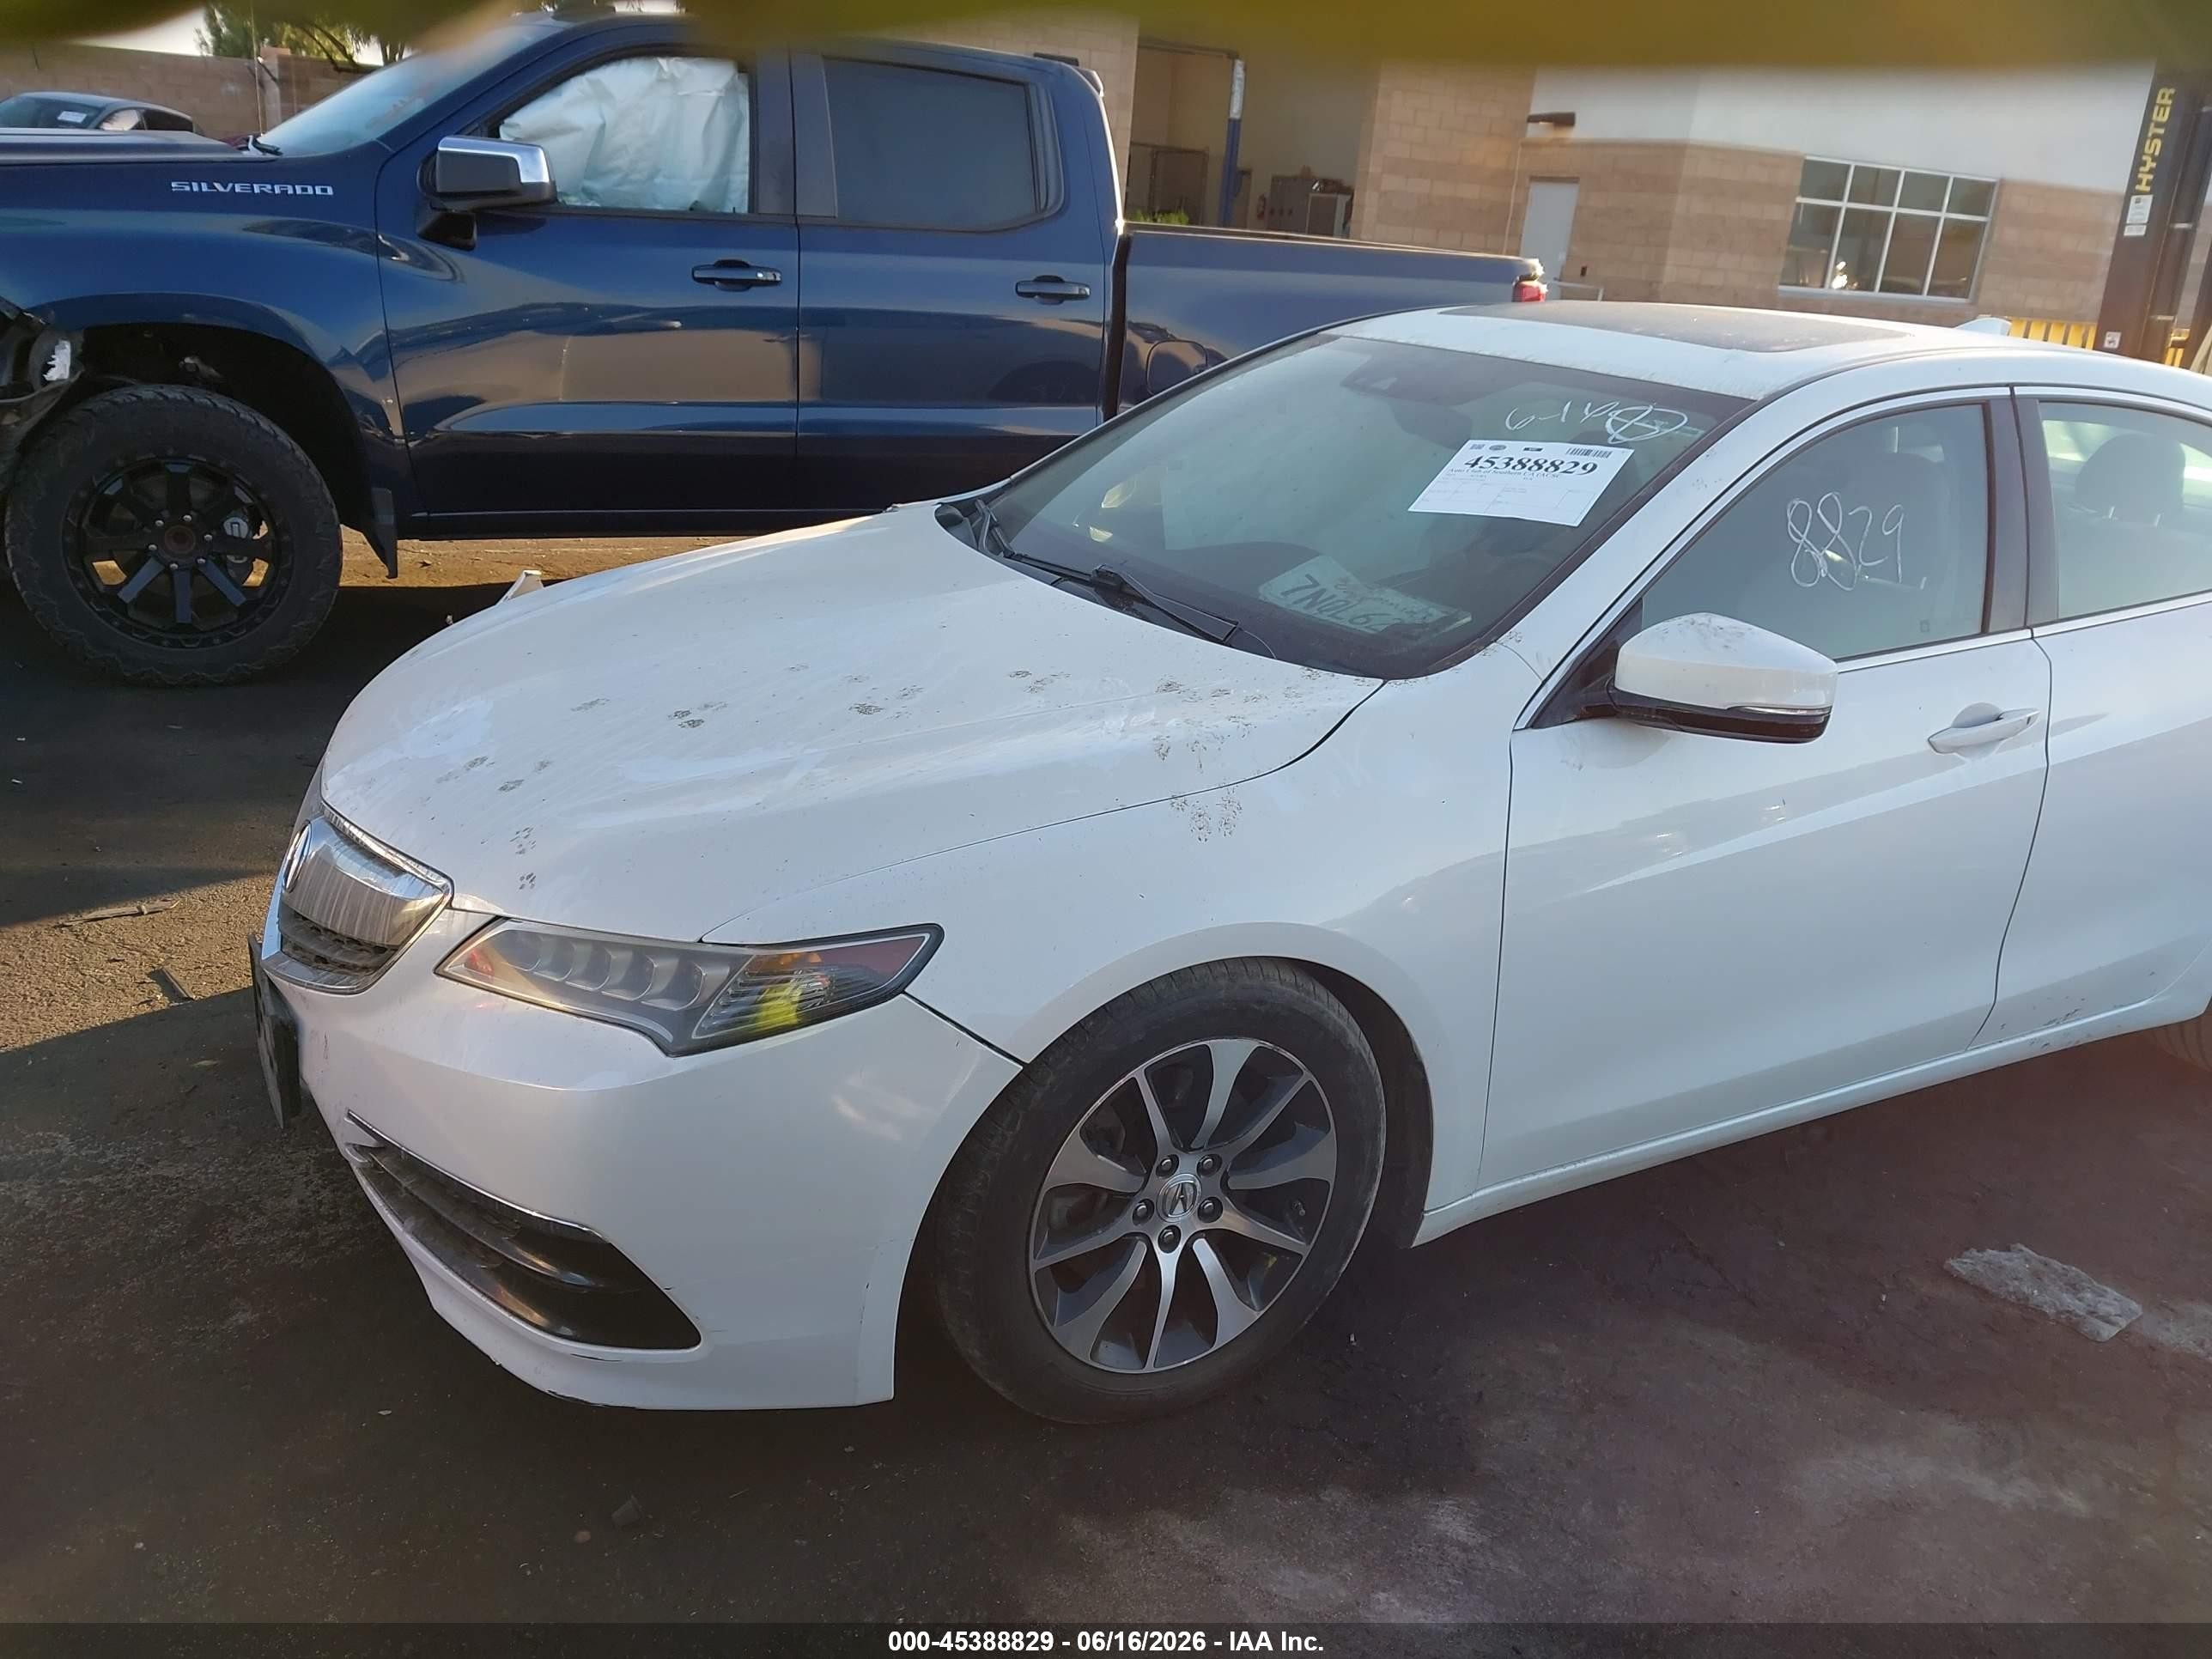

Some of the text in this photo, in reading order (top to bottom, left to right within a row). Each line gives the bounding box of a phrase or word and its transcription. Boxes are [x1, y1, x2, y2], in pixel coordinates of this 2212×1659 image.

[2135, 87, 2176, 192] HYSTER
[171, 181, 334, 196] SILVERADO
[1464, 455, 1598, 474] 45388829
[1787, 492, 1904, 591] 8829
[1279, 574, 1404, 632] 7NQL62
